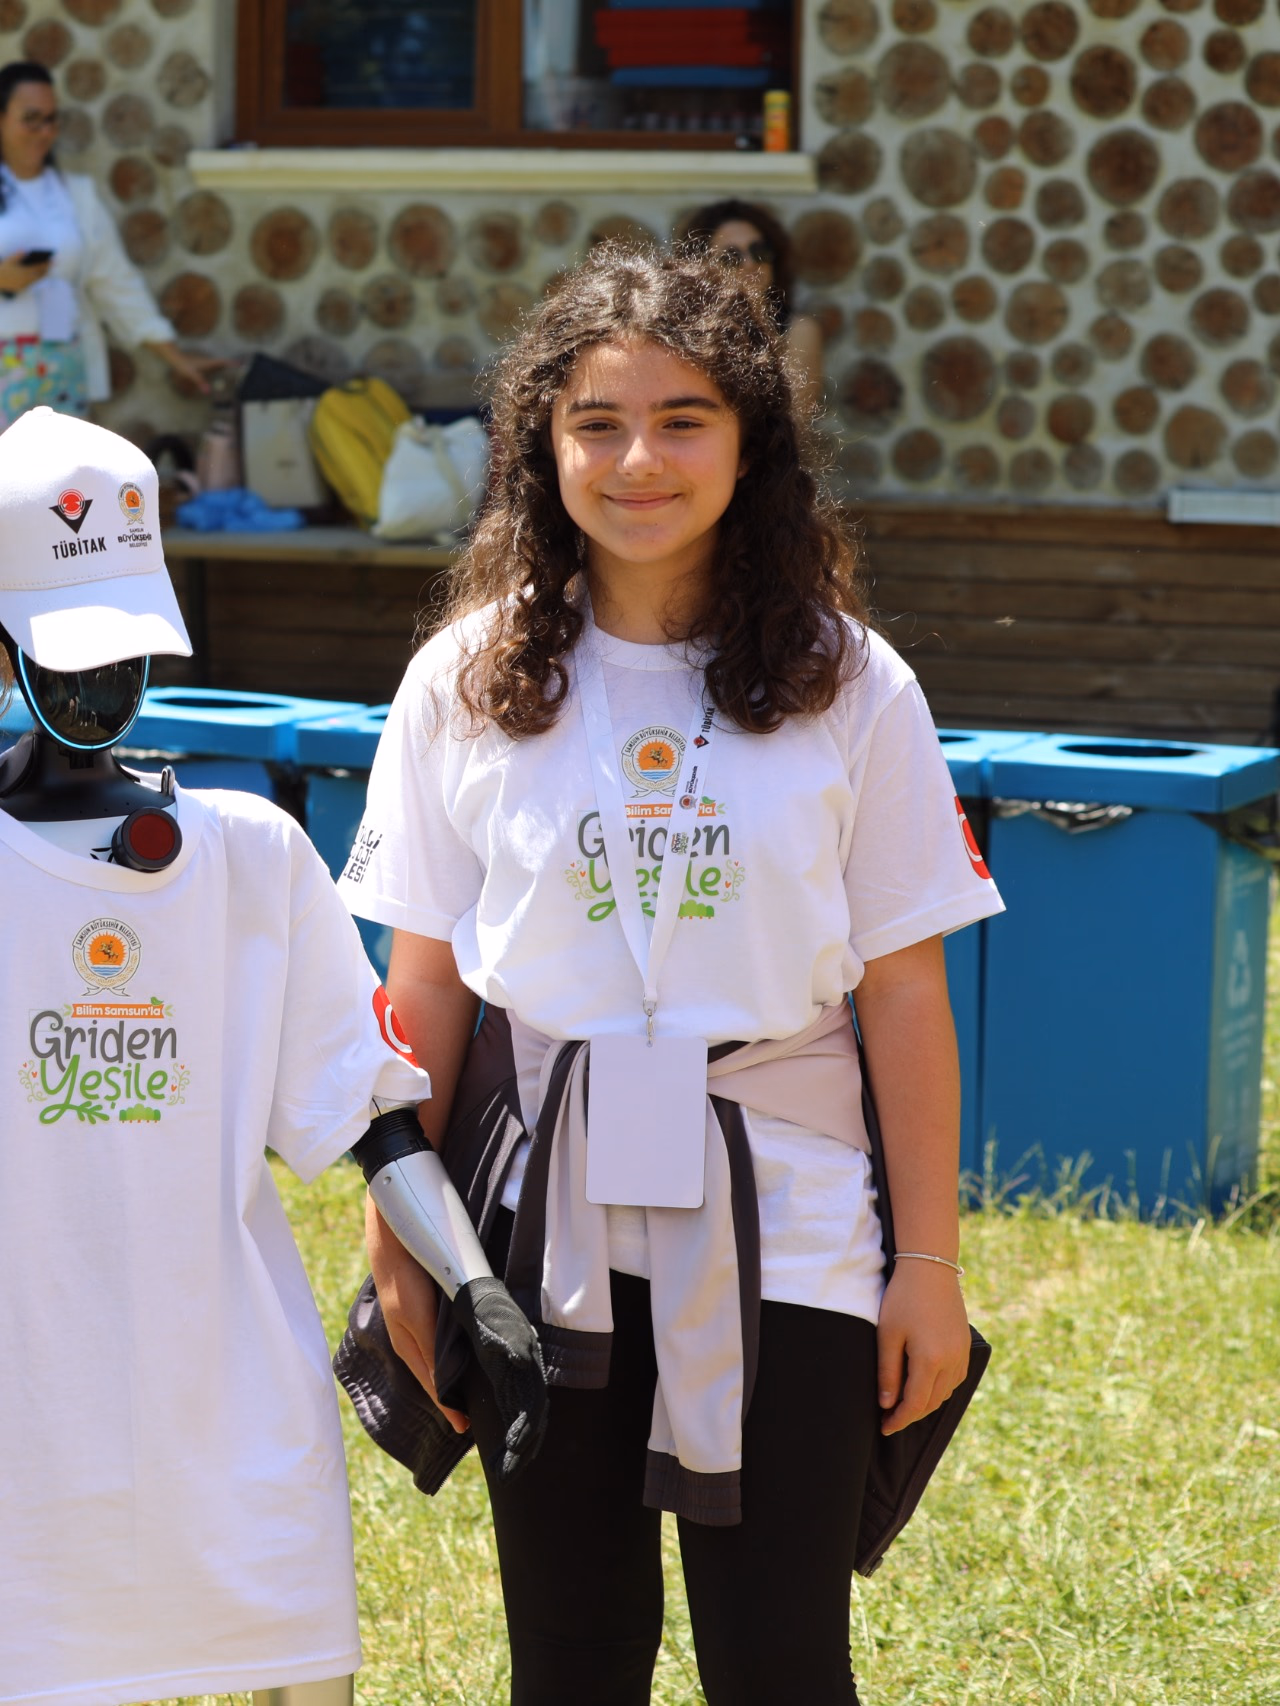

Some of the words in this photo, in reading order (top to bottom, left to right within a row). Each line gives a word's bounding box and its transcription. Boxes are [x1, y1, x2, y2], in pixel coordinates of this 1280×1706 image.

[52, 536, 107, 560] TÜBİTAK
[76, 928, 91, 945] SAMSUN
[76, 1004, 103, 1016] Bilim
[104, 1005, 161, 1016] Samsun'la
[30, 1010, 177, 1073] Griden
[39, 1054, 169, 1125] Yeşile
